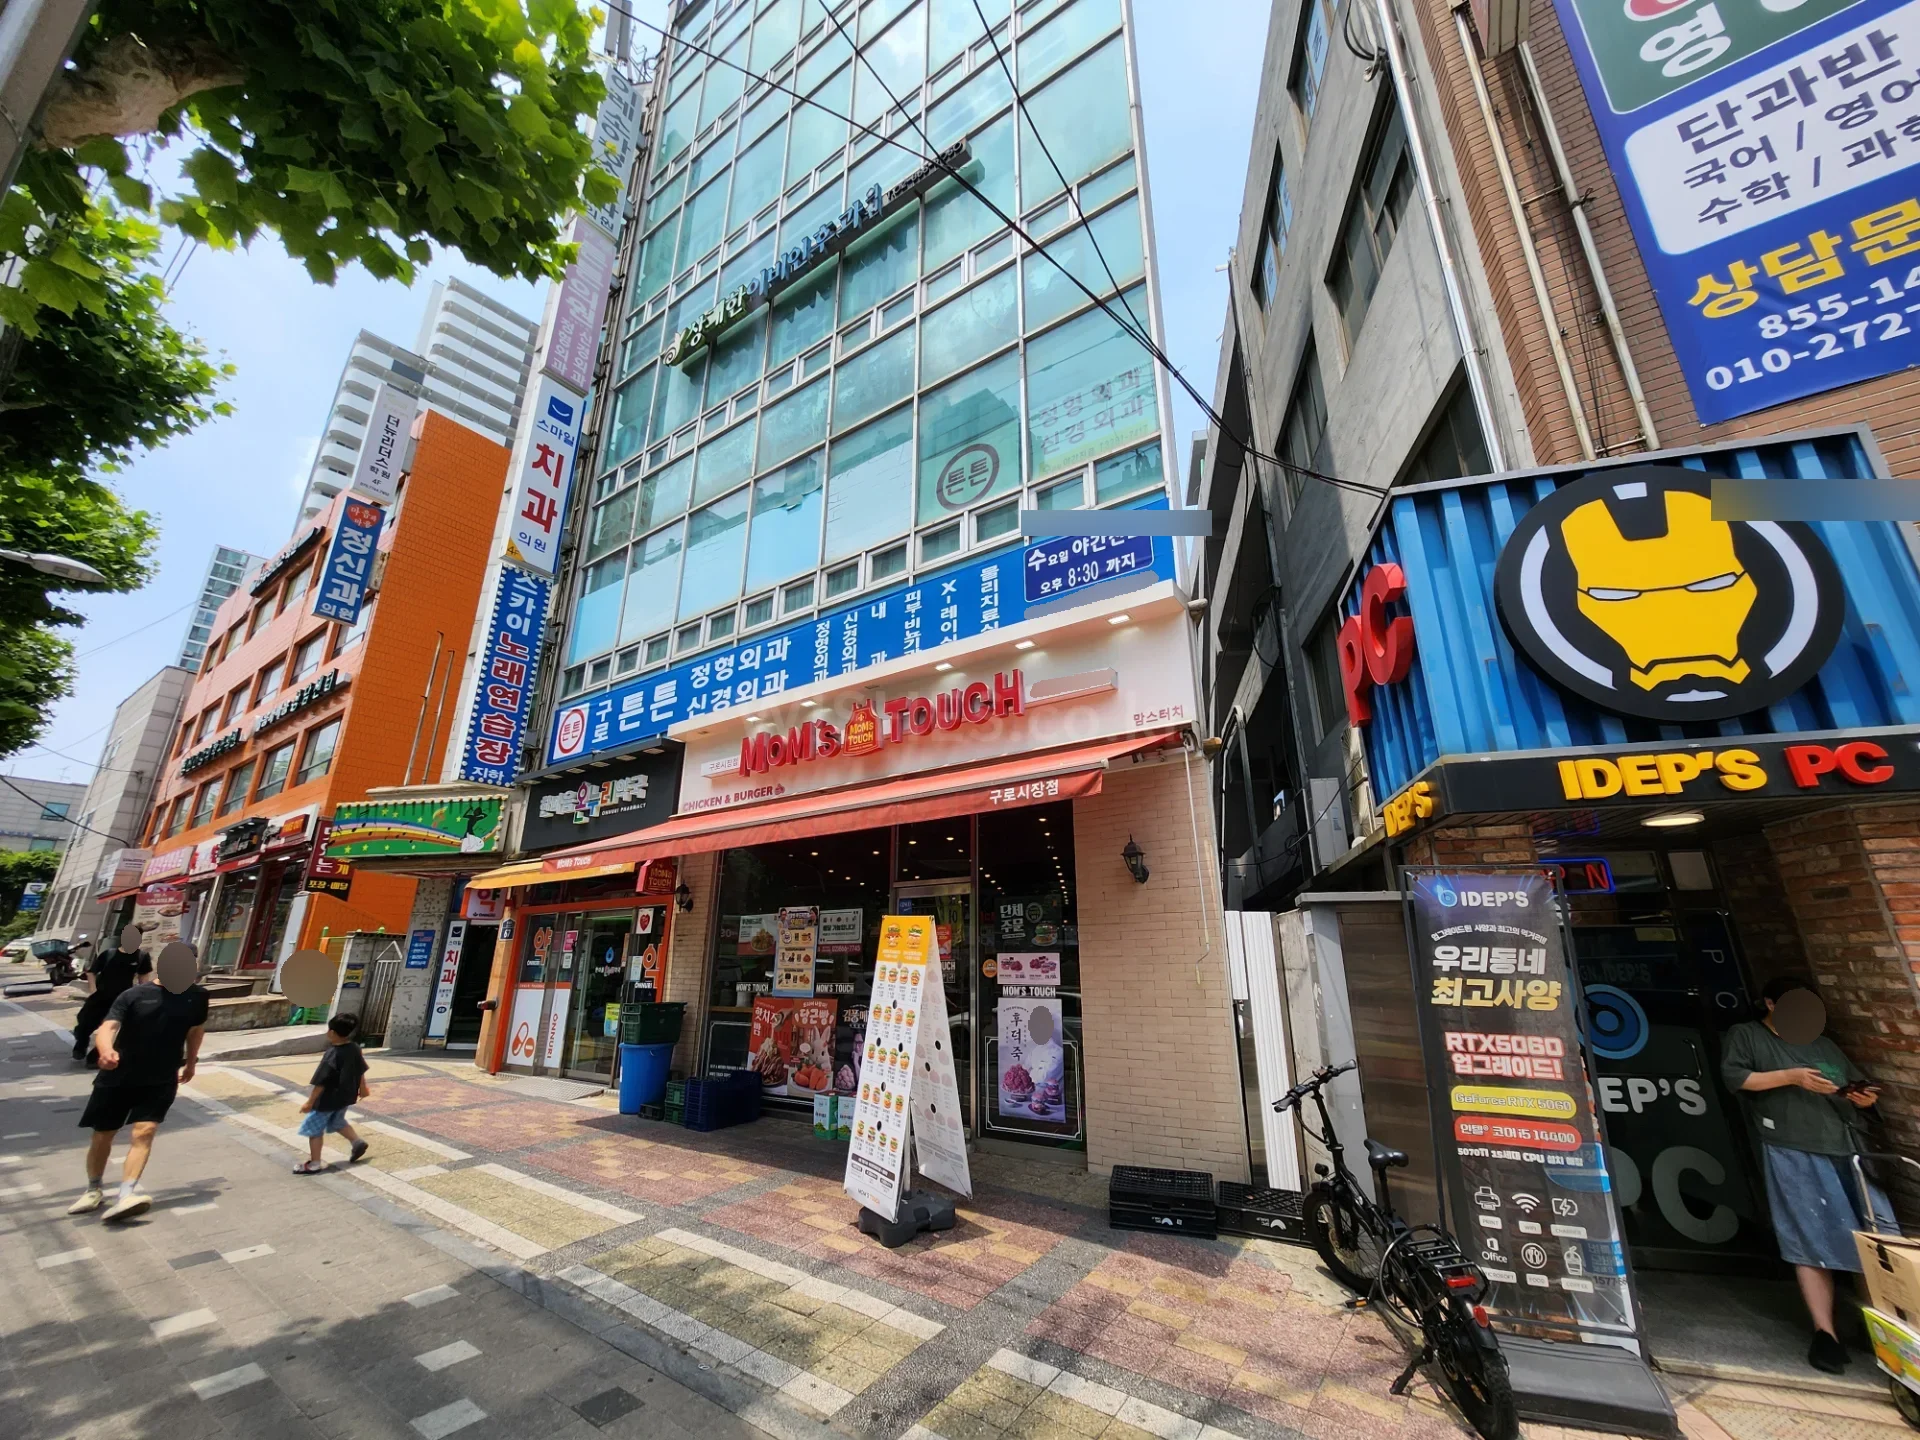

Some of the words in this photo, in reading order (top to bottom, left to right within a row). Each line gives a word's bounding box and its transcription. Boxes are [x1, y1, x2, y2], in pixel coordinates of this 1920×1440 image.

[1677, 28, 1902, 155] 단과반
[1683, 135, 1778, 188] 국어
[1698, 171, 1792, 226] 수학
[374, 414, 400, 470] 더뉴리더스
[536, 419, 575, 447] 스마일
[370, 465, 391, 480] 학원
[945, 457, 990, 494] 튼튼
[521, 443, 565, 534] 치과
[518, 532, 547, 553] 의원
[325, 527, 373, 607] 정신과
[1027, 548, 1069, 572] 수요일
[1040, 577, 1062, 594] 오후
[1068, 561, 1099, 587] 8:30
[1106, 552, 1135, 573] 까지
[319, 602, 355, 621] 의원
[690, 636, 791, 689] 정형외과
[618, 679, 678, 733] 튼튼
[686, 669, 790, 721] 신경외과
[884, 669, 1024, 742] TOUCH
[591, 700, 613, 744] 구로
[1133, 704, 1184, 727] 맘스터치
[848, 732, 874, 743] TOUCH
[471, 766, 504, 783] 지하
[709, 757, 738, 771] 구로시장점
[1558, 749, 1767, 801] IDEP'S
[1784, 742, 1895, 788] PC
[683, 796, 723, 812] CHICKEN
[734, 786, 773, 802] BURGER
[989, 778, 1059, 806] 구로시장점
[1000, 903, 1023, 918] 단체
[1460, 890, 1529, 908] IDEP'S
[1001, 918, 1024, 932] 주문
[441, 950, 458, 985] 치과
[1433, 945, 1546, 975] 우리동네
[1003, 985, 1026, 997] MOM'S
[1030, 986, 1056, 997] TOUCH
[1431, 976, 1562, 1011] 최고사양
[799, 1008, 831, 1026] 당근빵
[547, 1013, 558, 1059] ONNURI
[1010, 1012, 1023, 1062] 후덕죽
[1445, 1032, 1564, 1057] RTX5060
[1451, 1053, 1563, 1080] 업그레이드!
[1455, 1092, 1506, 1107] GeForce
[1507, 1096, 1535, 1109] RTX
[1537, 1098, 1572, 1112] 5060
[1533, 1130, 1576, 1144] 14400
[1522, 1153, 1545, 1163] CPU
[1481, 1251, 1508, 1264] Office
